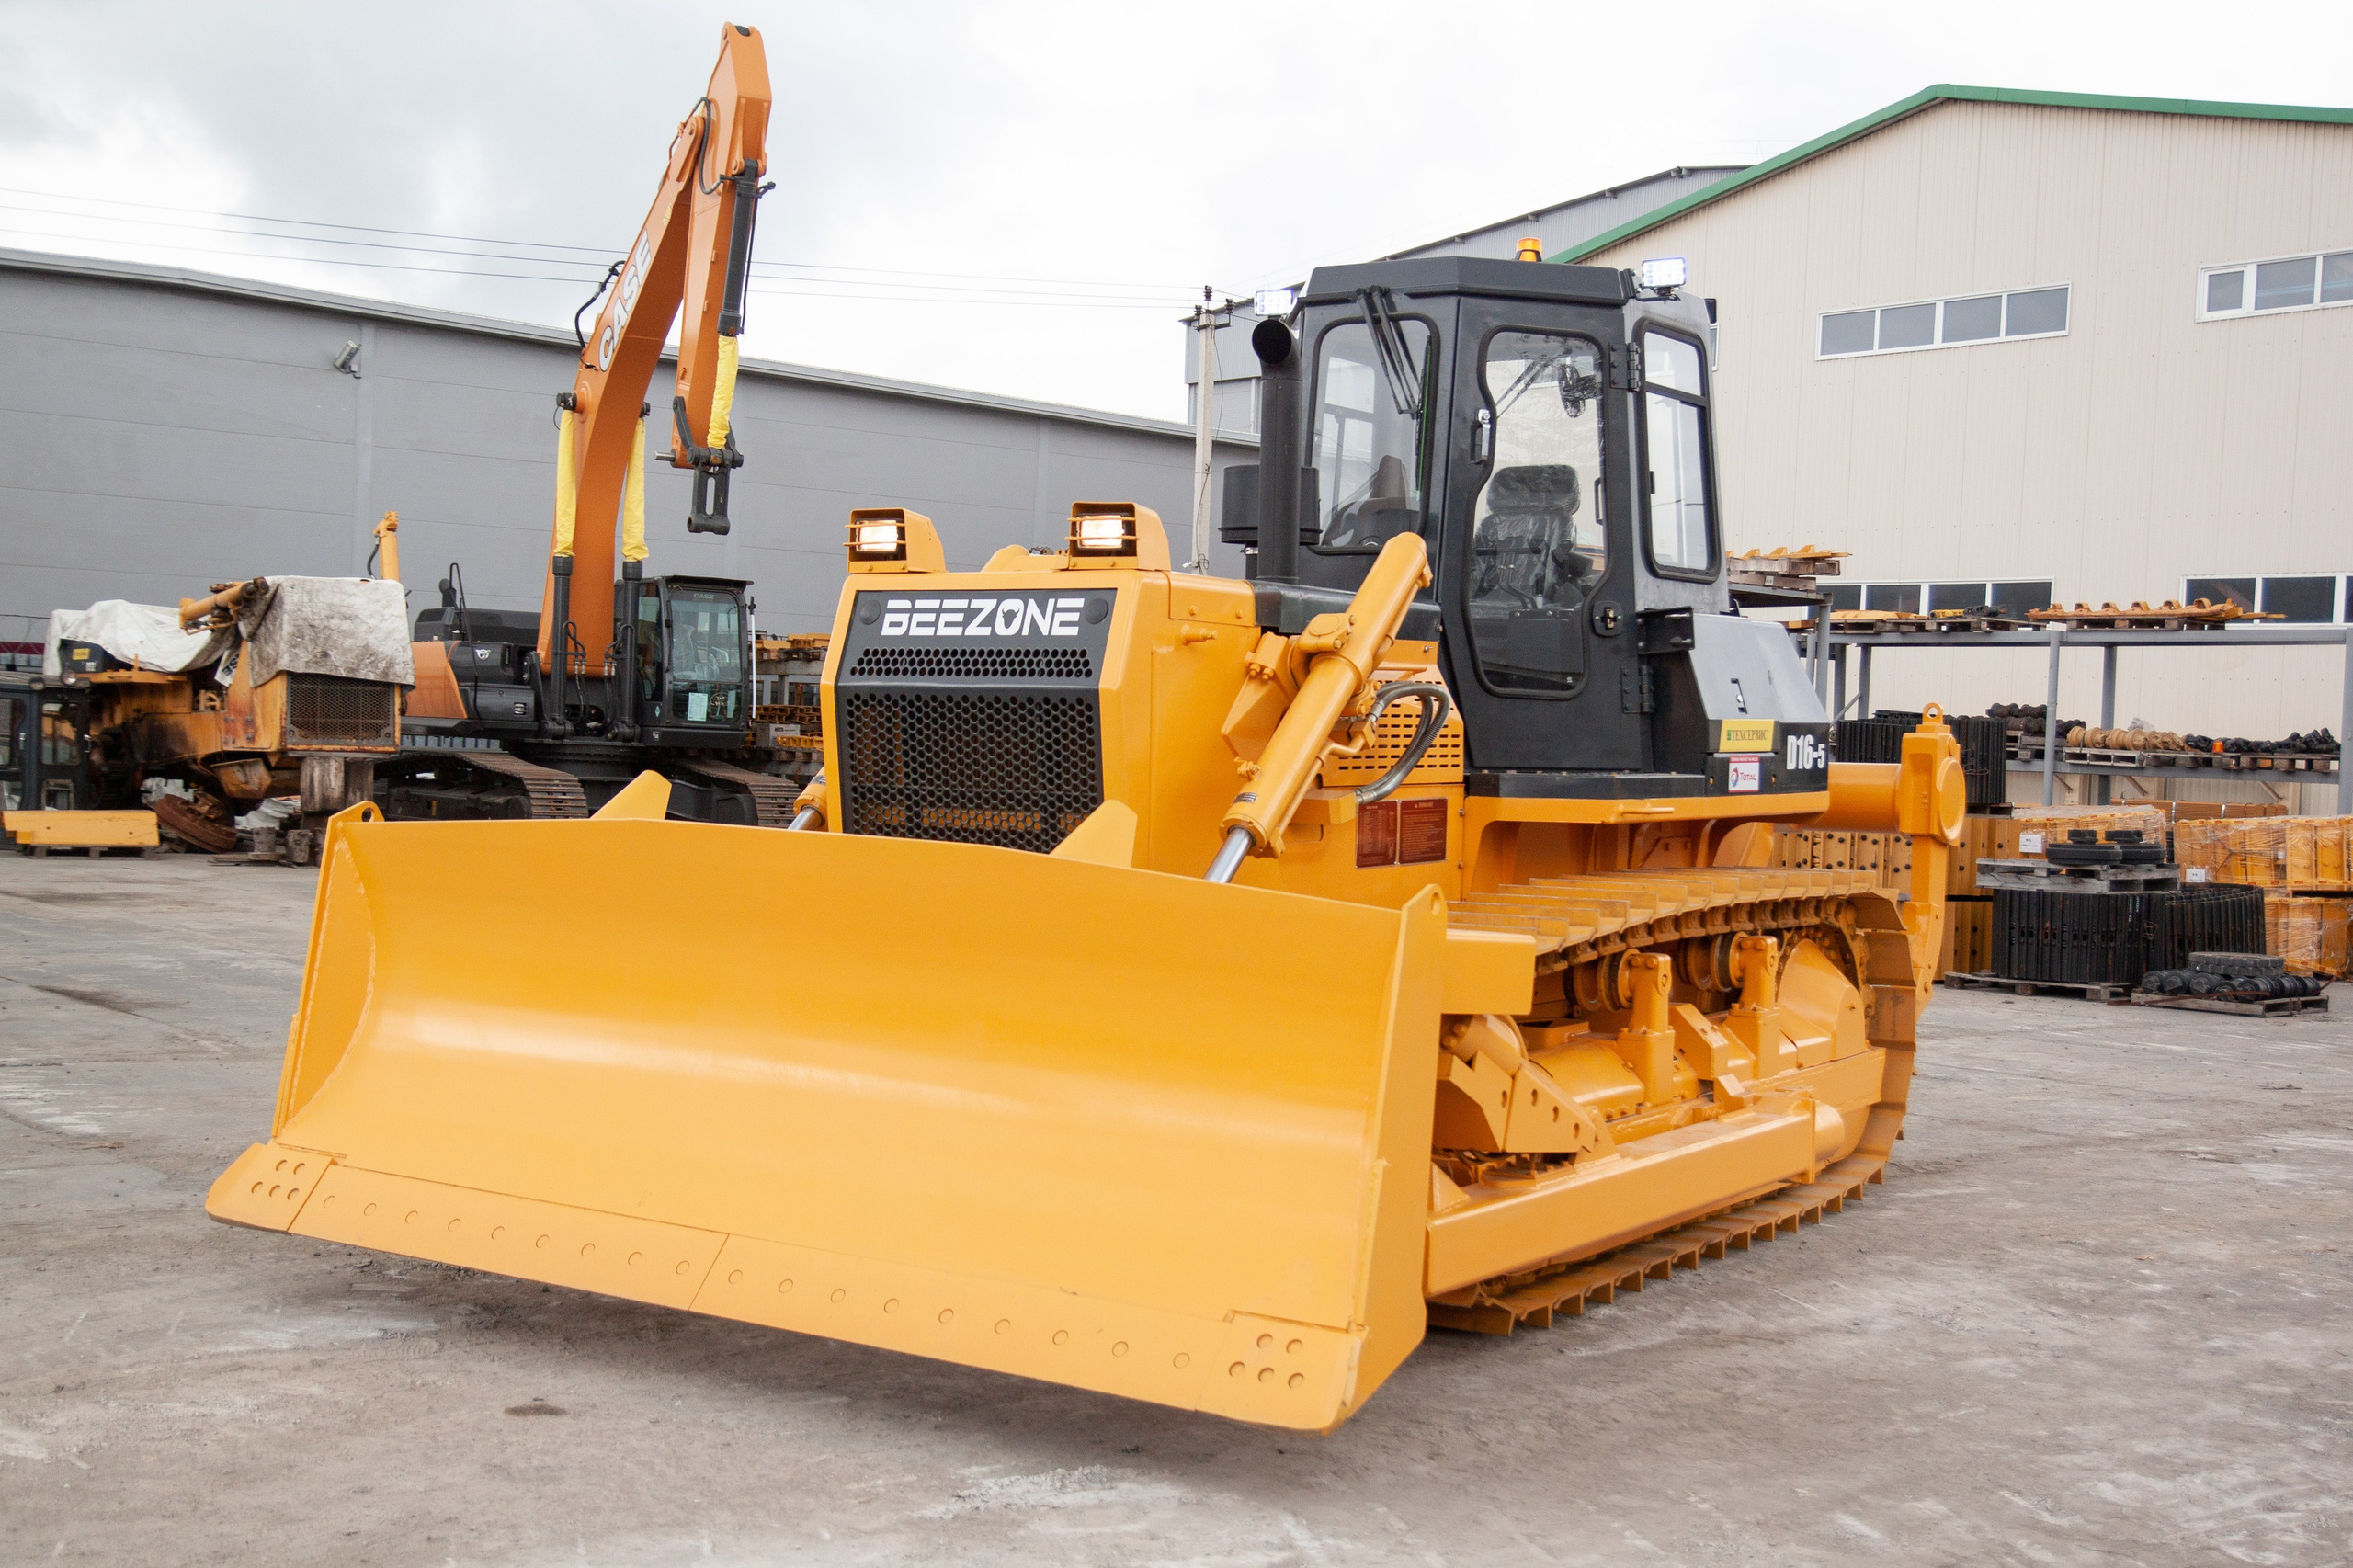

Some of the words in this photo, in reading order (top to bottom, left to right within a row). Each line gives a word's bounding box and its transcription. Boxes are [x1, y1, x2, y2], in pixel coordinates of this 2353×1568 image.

[598, 227, 652, 372] CASE
[881, 597, 1086, 636] BEEZONE
[1732, 729, 1768, 741] ТЕХСЕРВИС
[1786, 734, 1825, 770] D16-5
